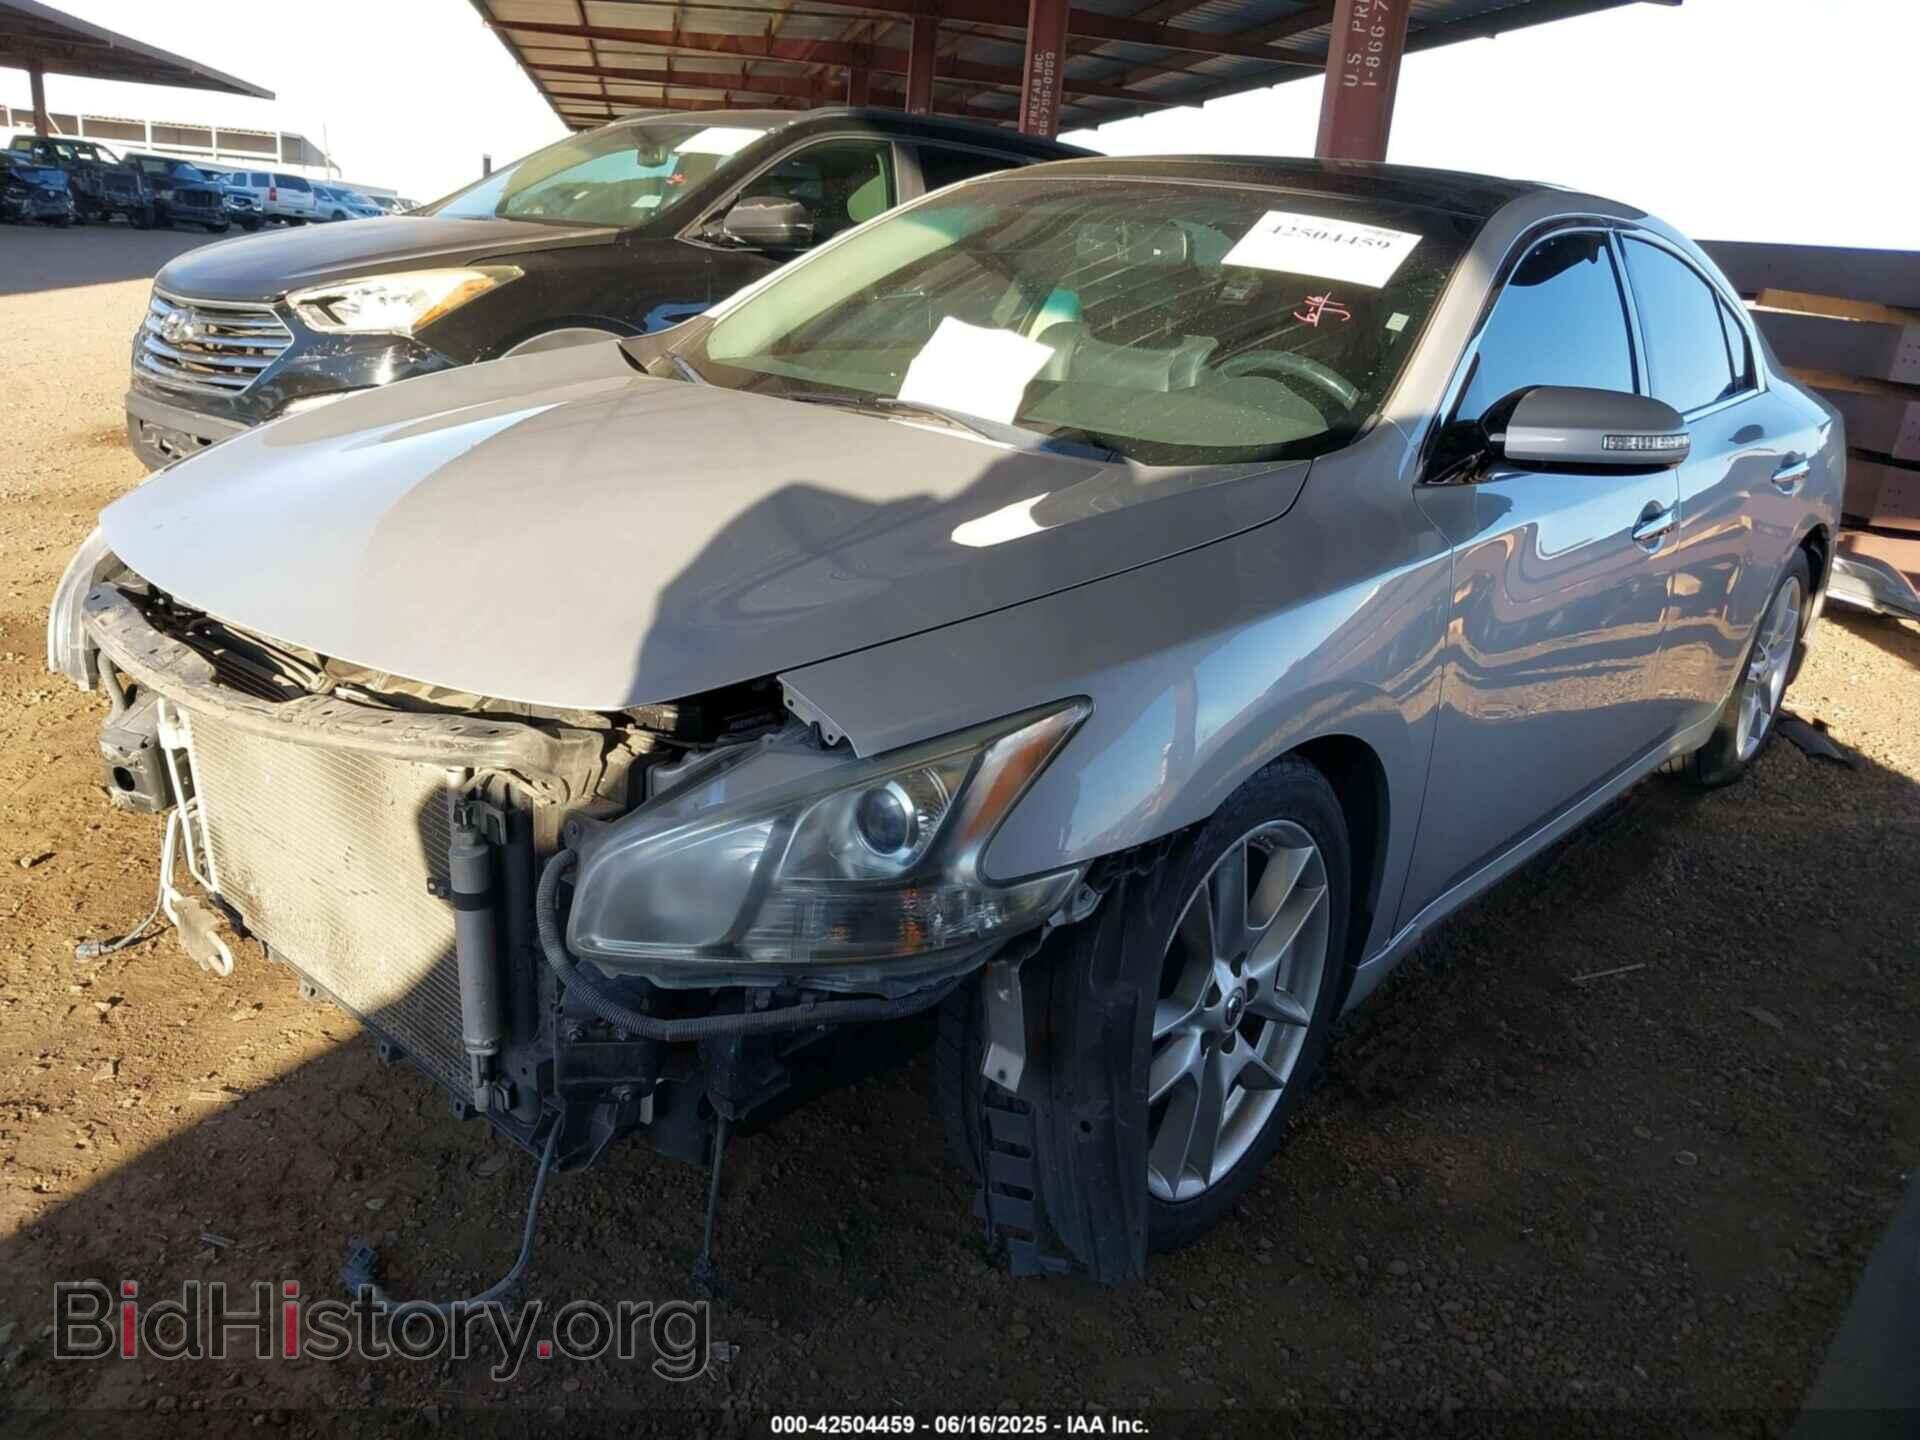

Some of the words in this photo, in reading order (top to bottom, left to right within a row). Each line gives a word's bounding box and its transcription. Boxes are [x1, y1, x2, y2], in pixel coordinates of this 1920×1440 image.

[1343, 47, 1363, 88] U.S.
[1028, 79, 1042, 127] PREFAB
[1268, 223, 1392, 250] 42504459
